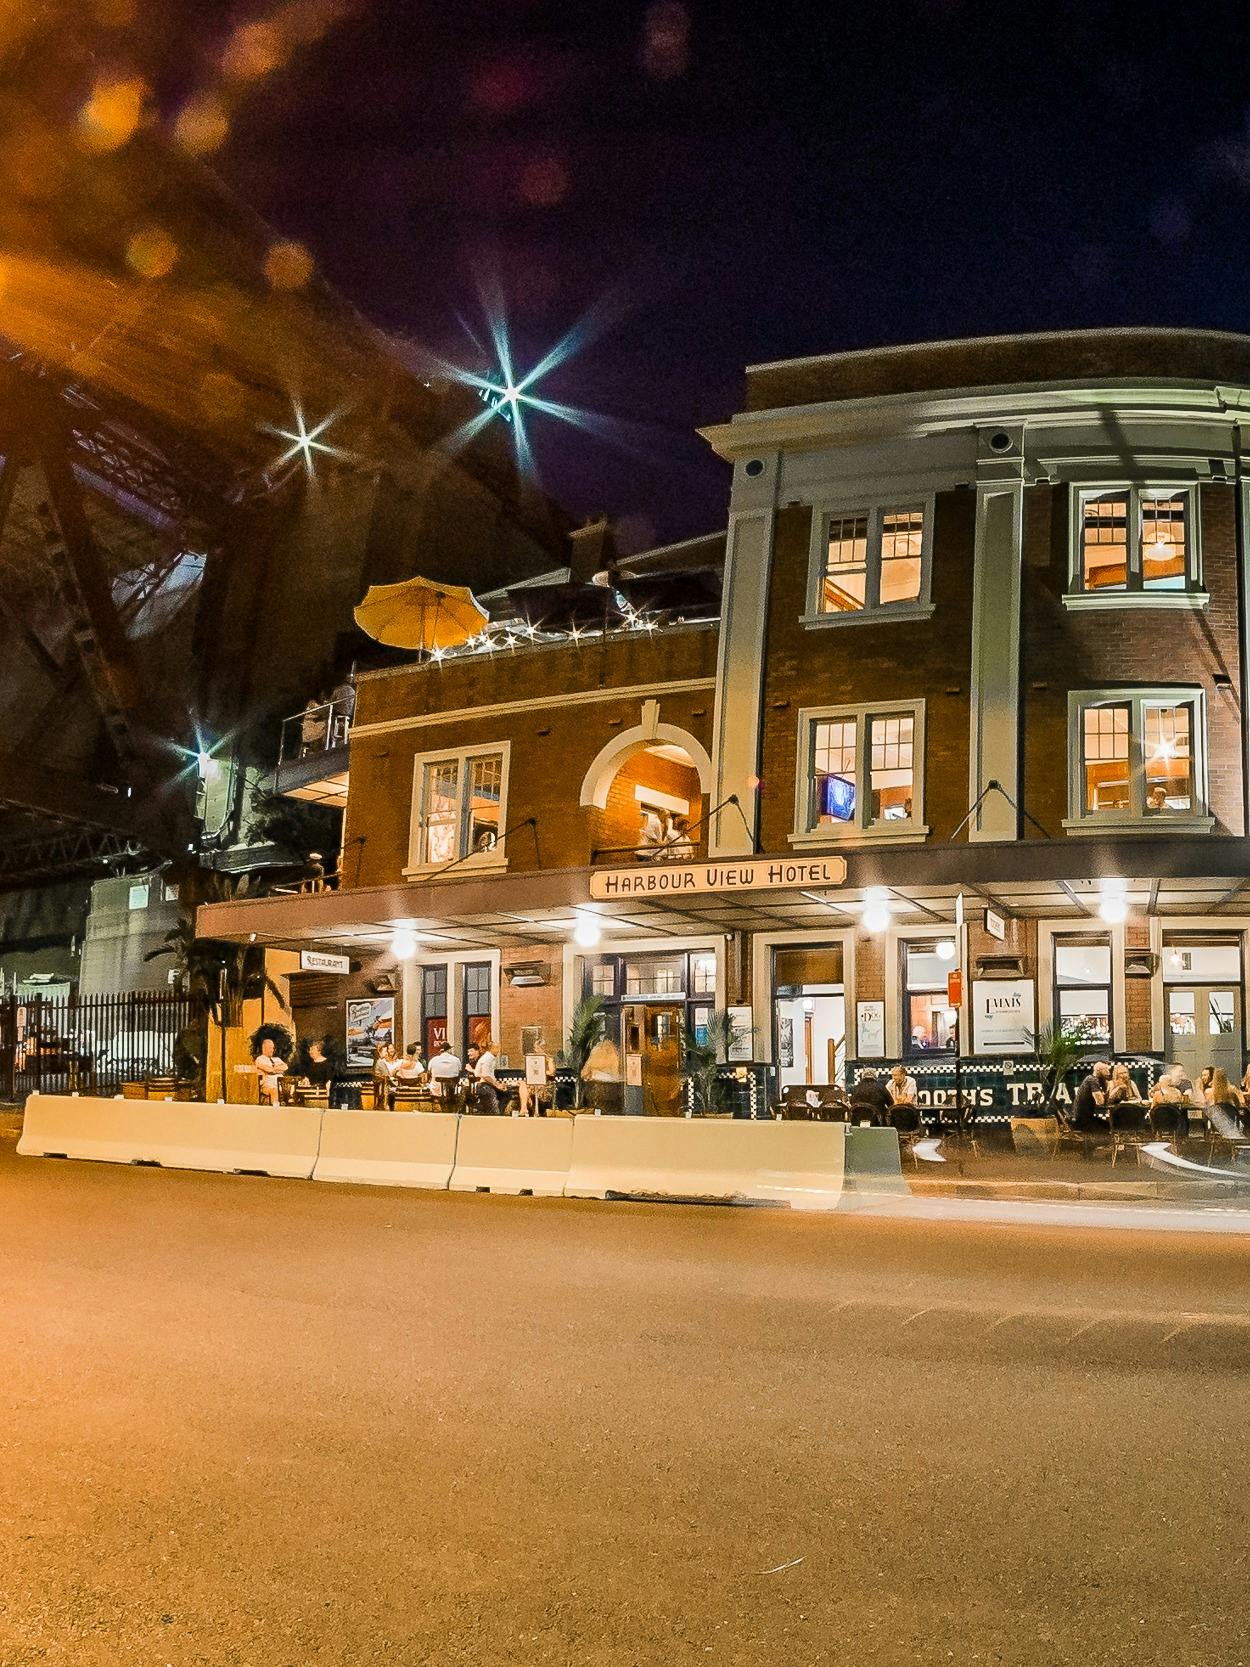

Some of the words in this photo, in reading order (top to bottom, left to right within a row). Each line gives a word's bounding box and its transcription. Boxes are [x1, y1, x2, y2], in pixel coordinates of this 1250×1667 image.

[605, 872, 696, 893] HARBOUR
[706, 868, 754, 887] VIEW
[768, 864, 831, 883] HOTEL
